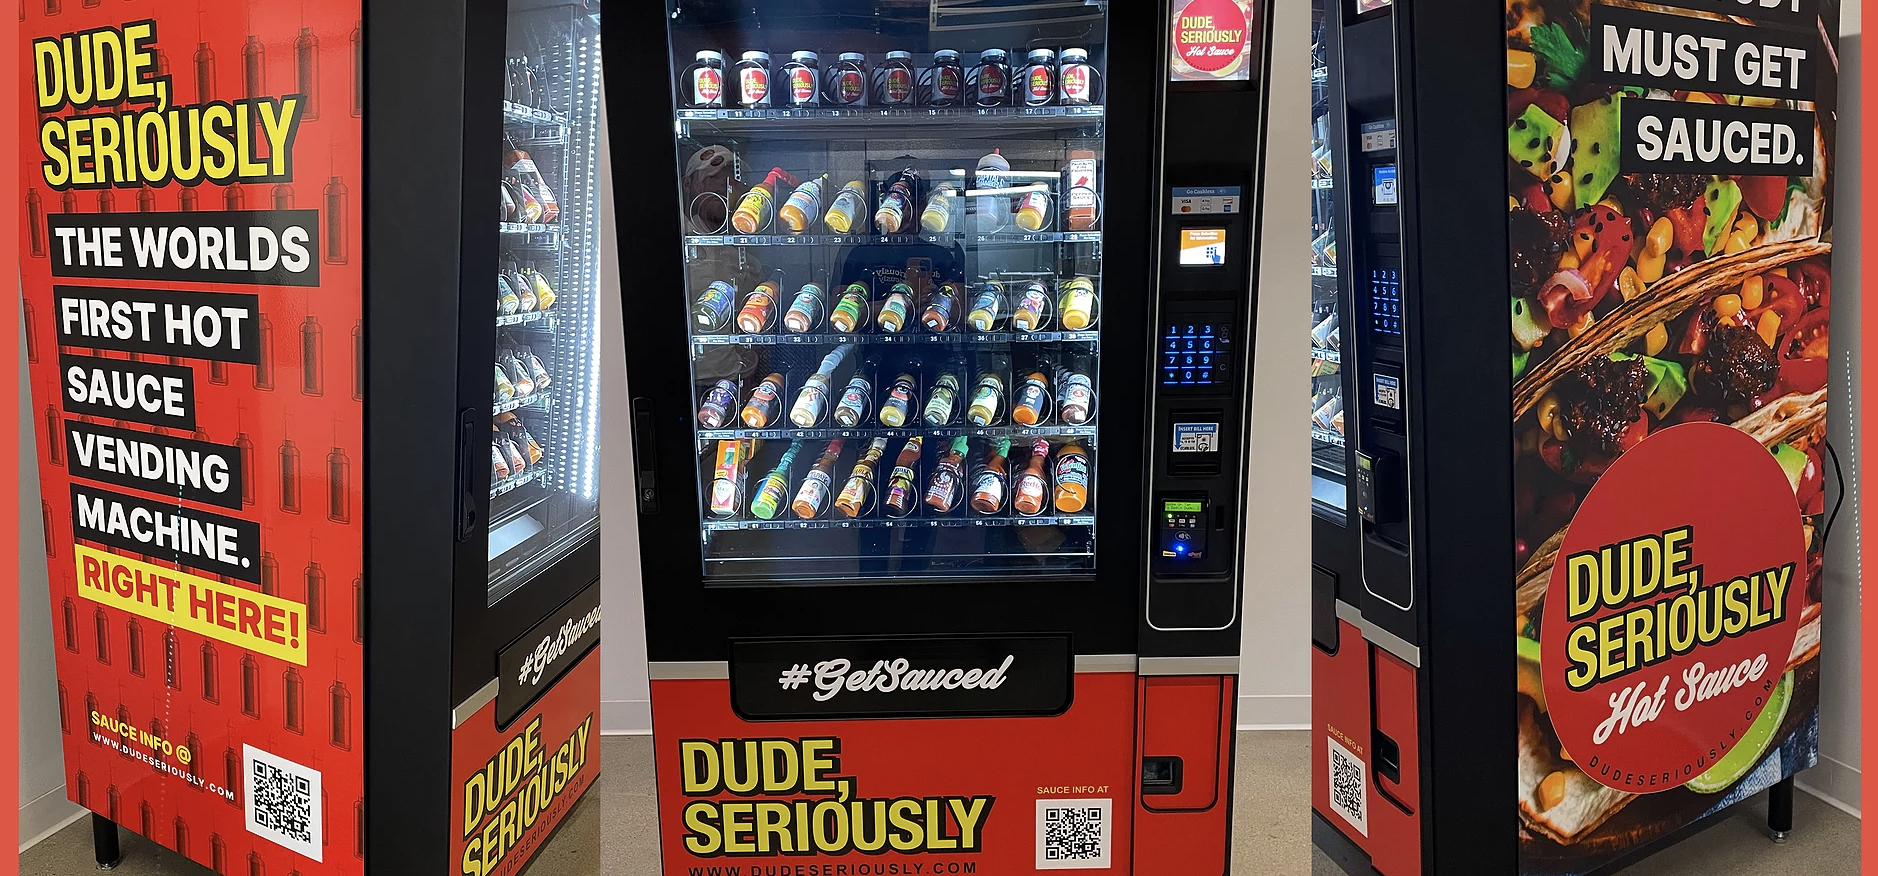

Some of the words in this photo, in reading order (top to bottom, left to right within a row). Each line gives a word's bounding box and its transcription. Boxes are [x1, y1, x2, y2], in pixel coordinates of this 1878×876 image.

[1181, 30, 1242, 44] SERIOUSLY
[1182, 16, 1215, 31] DUDE,
[35, 25, 166, 109] DUDE,
[1186, 45, 1206, 57] Hot
[1207, 45, 1235, 56] Sauce
[1603, 25, 1726, 80] MUST
[1734, 40, 1806, 91] GET
[41, 99, 297, 184] SERIOUSLY
[1637, 115, 1804, 165] SAUCED.
[55, 227, 121, 267] THE
[133, 227, 310, 273] WORLDS
[1373, 270, 1377, 278] 1
[1382, 270, 1387, 279] 2
[1391, 271, 1396, 279] 3
[1373, 286, 1378, 294] 4
[1382, 287, 1387, 295] 5
[1391, 287, 1397, 296] 6
[1373, 302, 1378, 310] 7
[1383, 302, 1388, 311] 8
[1392, 303, 1397, 313] 9
[61, 298, 156, 341] FIRST
[165, 306, 249, 350] HOT
[1170, 341, 1176, 349] 4
[1187, 341, 1193, 349] 5
[1204, 341, 1210, 349] 6
[1171, 326, 1176, 334] 1
[1188, 326, 1194, 334] 2
[1205, 326, 1211, 334] 3
[1383, 319, 1388, 328] 0
[1169, 356, 1176, 364] 7
[1186, 356, 1193, 364] 8
[1203, 356, 1210, 364] 9
[1185, 371, 1192, 379] 0
[67, 366, 184, 416] SAUCE
[71, 431, 229, 493] VENDING
[77, 495, 250, 568] MACHINE.
[1568, 529, 1698, 617] DUDE,
[83, 555, 180, 599] RIGHT
[189, 583, 299, 648] HERE!
[1567, 566, 1791, 687] SERIOUSLY
[778, 655, 1014, 700] #GetSauced
[1593, 675, 1670, 745] Hot
[1674, 653, 1768, 711] Sauce
[91, 711, 137, 741] SAUCE
[140, 729, 173, 756] INFO
[176, 745, 191, 764] @
[1327, 723, 1344, 742] SAUCE
[1344, 735, 1357, 750] INFO
[1356, 744, 1364, 755] AT
[1589, 679, 1773, 786] DUDESERIOUSLY.COM
[93, 732, 234, 800] WWW.DUDESERIOUSLY.COM
[465, 718, 544, 837] DUDE,
[683, 740, 849, 800] DUDE,
[1037, 786, 1070, 794] SAUCE
[1072, 786, 1095, 794] INFO
[1097, 785, 1109, 793] AT
[462, 716, 591, 876] SERIOUSLY
[685, 798, 985, 854] SERIOUSLY
[688, 862, 977, 876] WWW.DUDESERIOUSLY.COM
